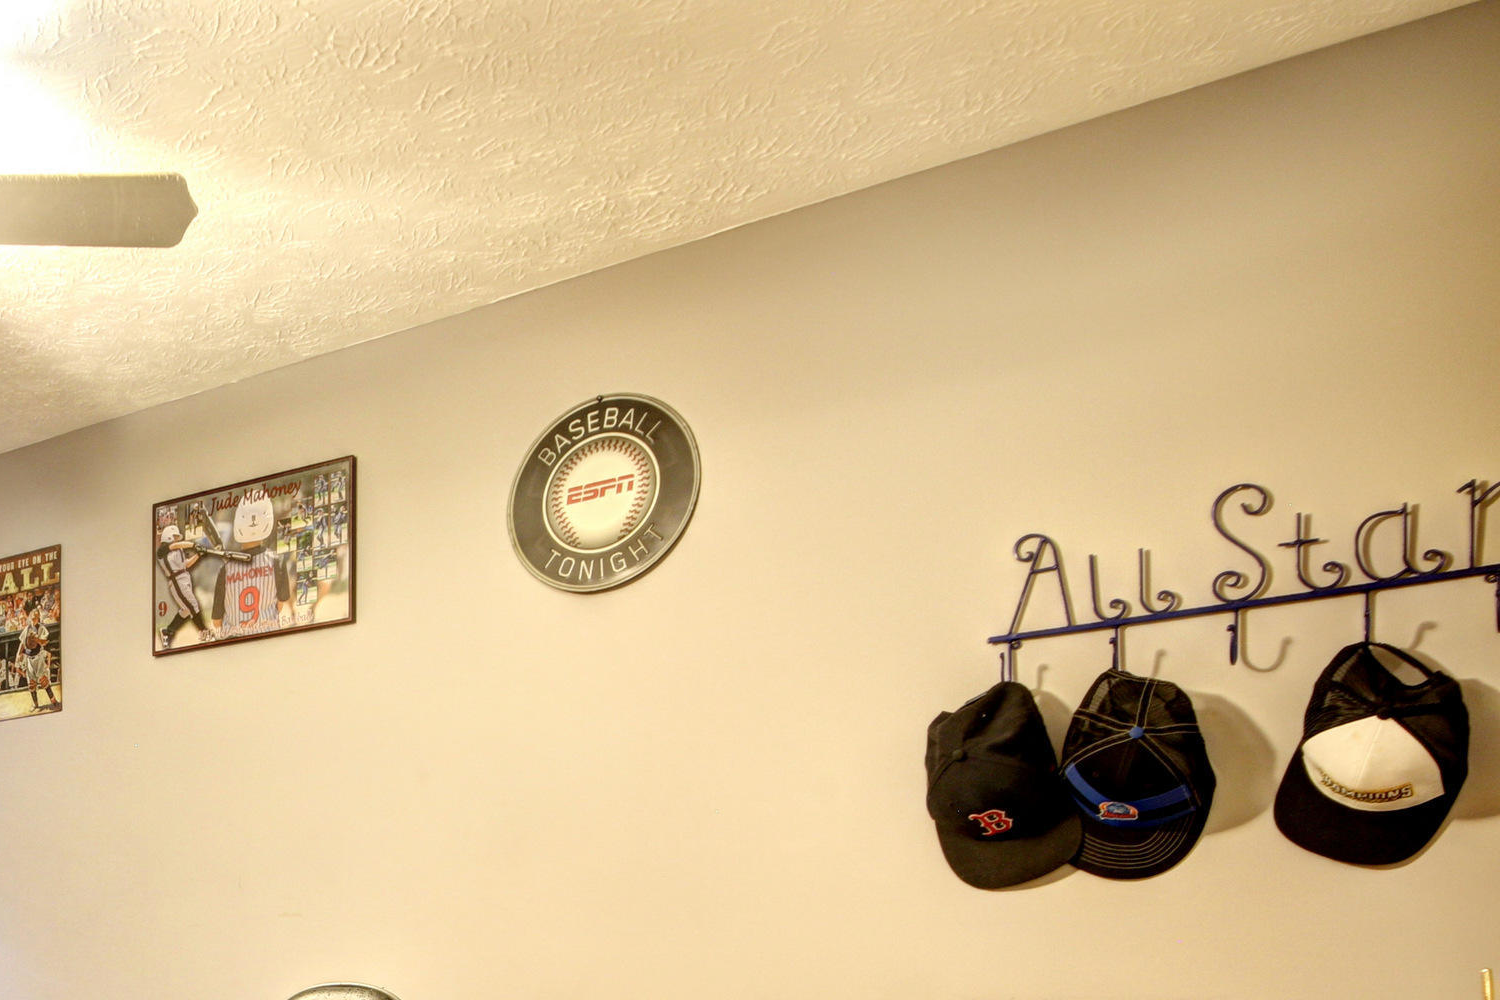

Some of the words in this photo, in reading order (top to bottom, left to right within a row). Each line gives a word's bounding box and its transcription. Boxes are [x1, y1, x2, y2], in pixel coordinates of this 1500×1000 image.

[538, 407, 662, 467] BASEBALL
[208, 492, 240, 517] Jude
[243, 480, 302, 505] Mahoney
[566, 474, 635, 505] ESPN
[0, 562, 14, 573] YOUR
[17, 558, 29, 568] EYE
[32, 555, 42, 565] ON
[45, 551, 58, 562] THE
[544, 523, 663, 580] TONIGHT
[226, 566, 274, 584] MAHONEY
[158, 601, 168, 617] 9
[238, 586, 260, 627] 9
[969, 809, 1013, 837] B
